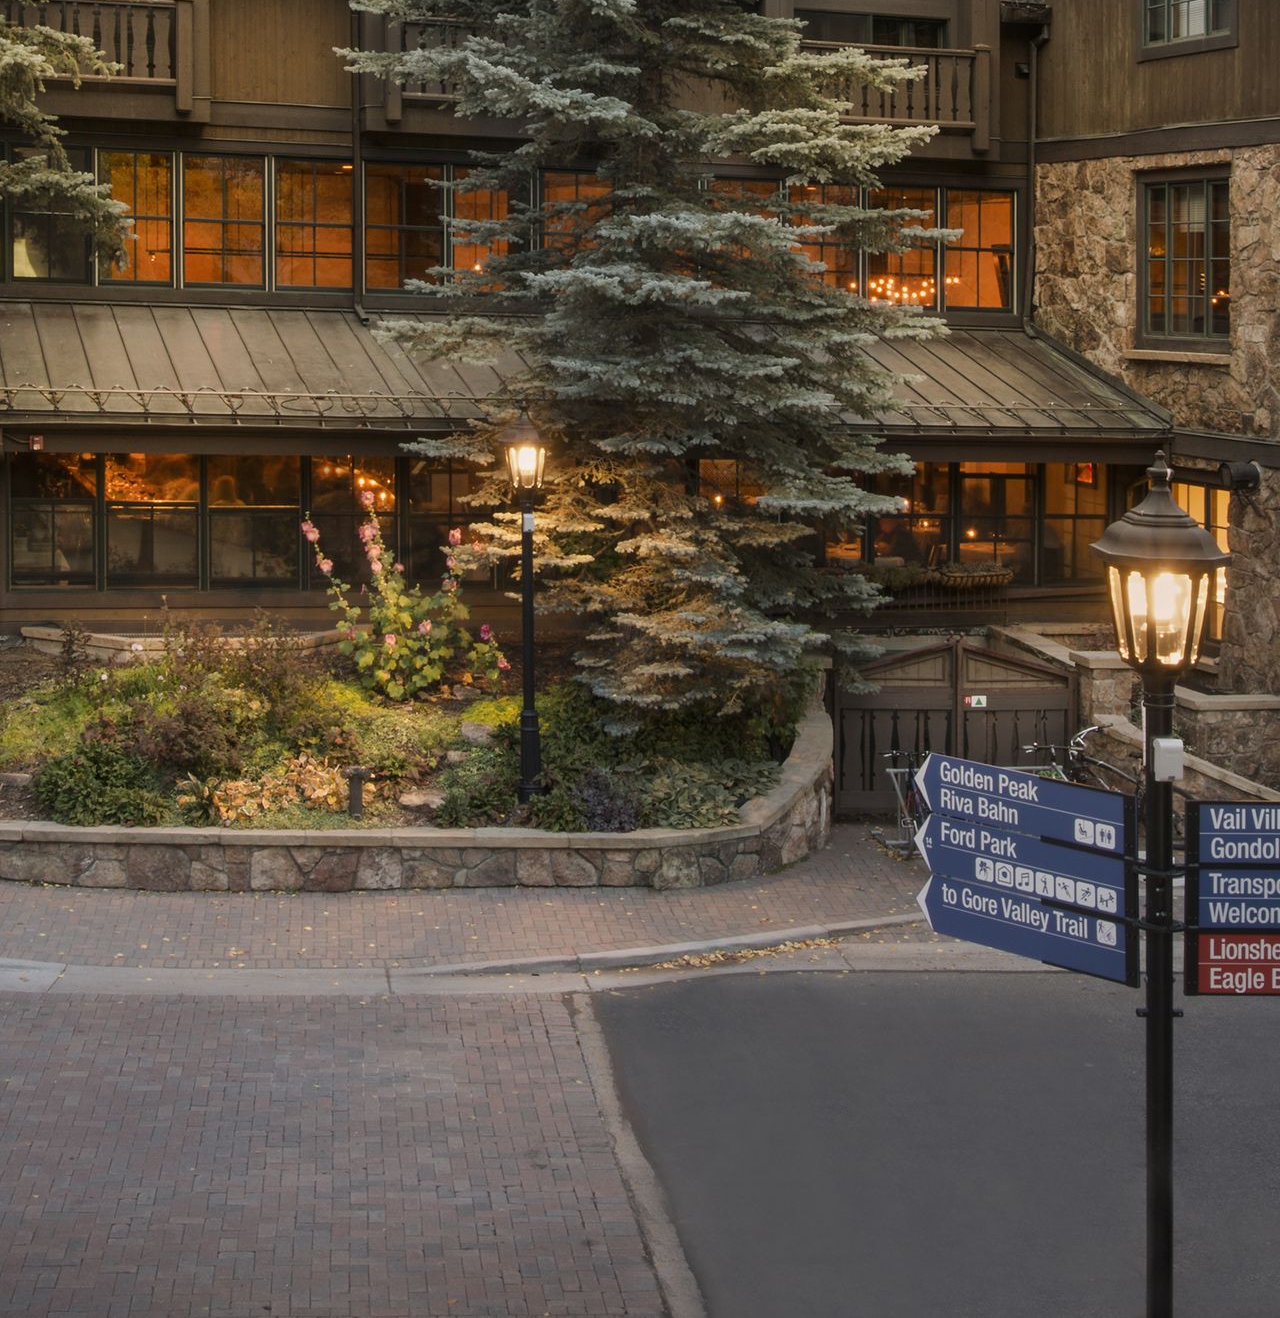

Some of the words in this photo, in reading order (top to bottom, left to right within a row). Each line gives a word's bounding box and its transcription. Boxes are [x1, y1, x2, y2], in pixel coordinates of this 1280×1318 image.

[939, 761, 993, 791] Golden
[998, 774, 1039, 802] Peak
[940, 789, 973, 815] Riva
[978, 801, 1018, 825] Bahn
[1210, 808, 1246, 830] Vail
[940, 822, 975, 849] Ford
[980, 831, 1017, 858] Park
[941, 883, 957, 904] to
[962, 888, 998, 916] Gore
[1001, 897, 1049, 932] Valley
[1053, 910, 1088, 939] Trail
[1209, 968, 1265, 993] Eagle
